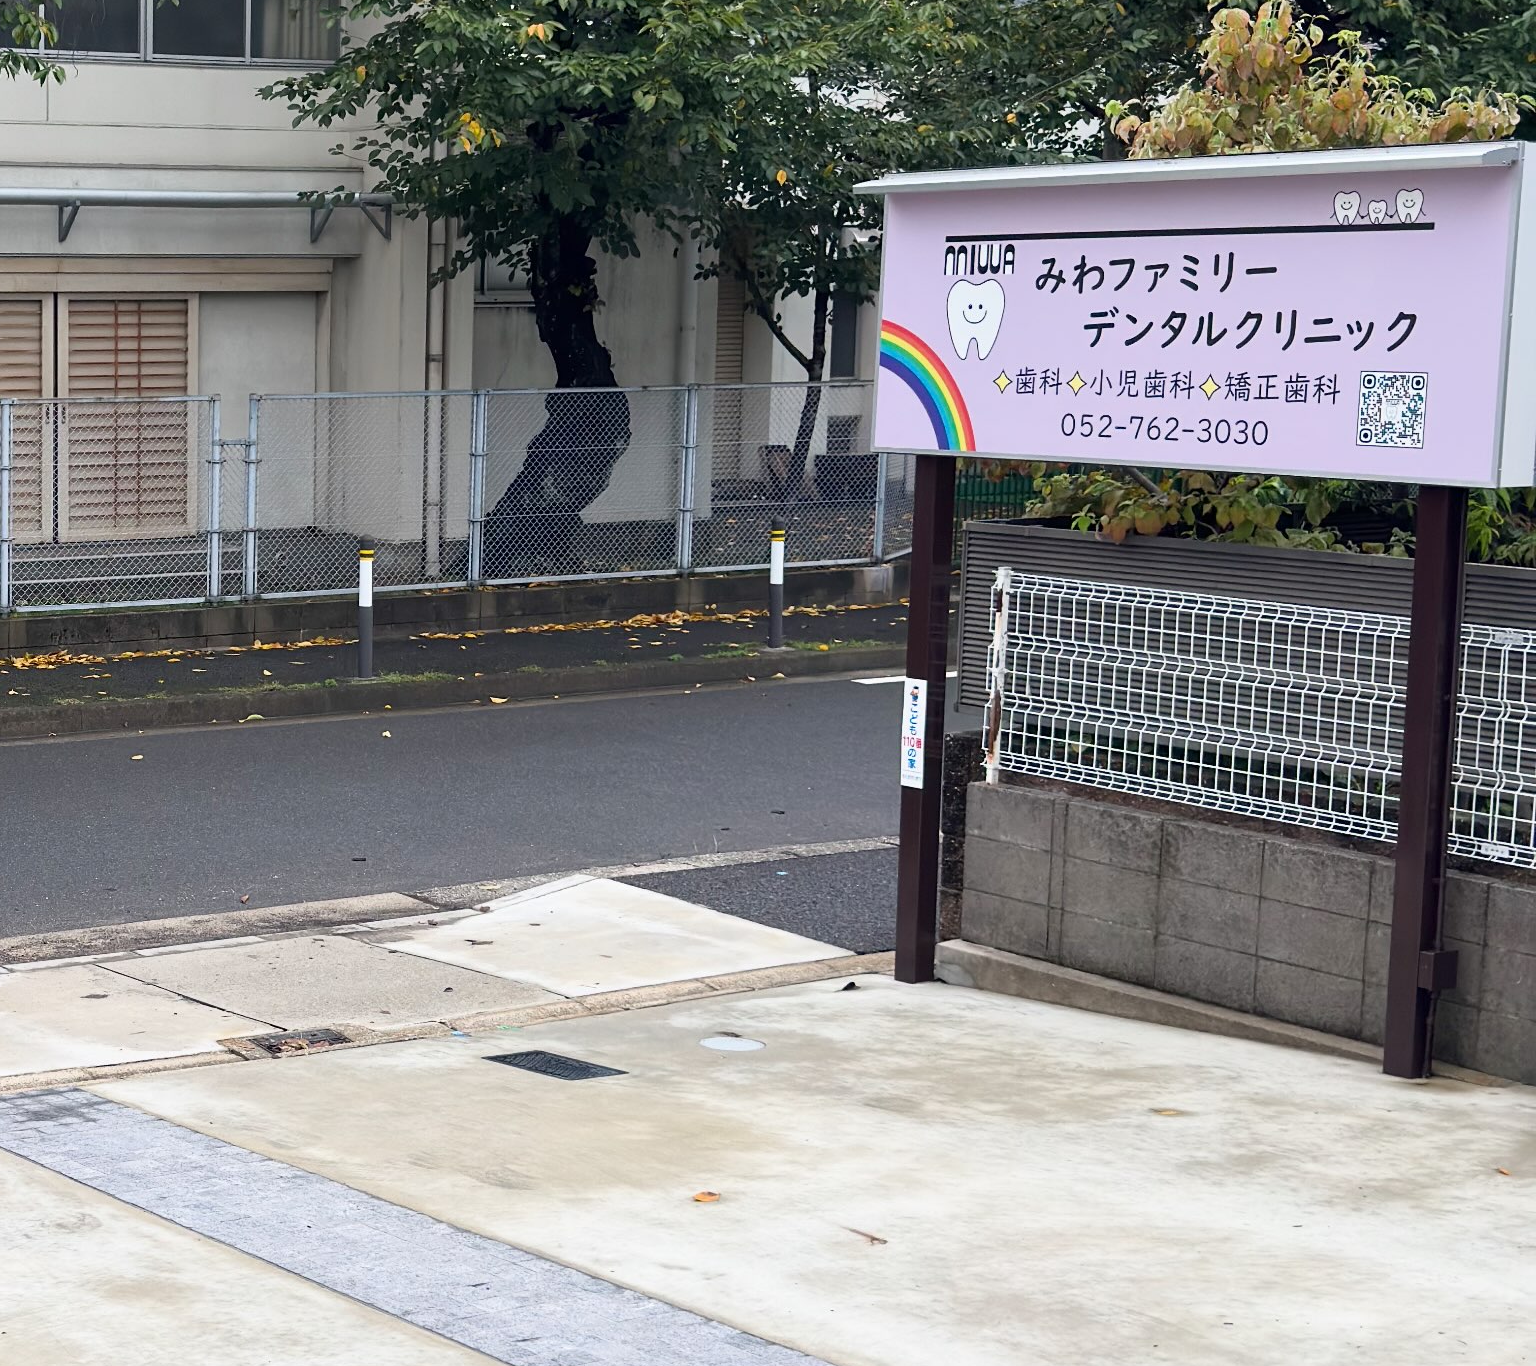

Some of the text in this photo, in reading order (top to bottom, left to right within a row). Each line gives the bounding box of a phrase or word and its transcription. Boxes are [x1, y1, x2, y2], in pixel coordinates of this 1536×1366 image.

[1035, 251, 1278, 295] みわファミリー
[1083, 306, 1417, 352] デンタルクリニック
[1014, 366, 1341, 405] 歯科 小児歯科 矯正歯科
[1060, 412, 1269, 446] 052-762-3030
